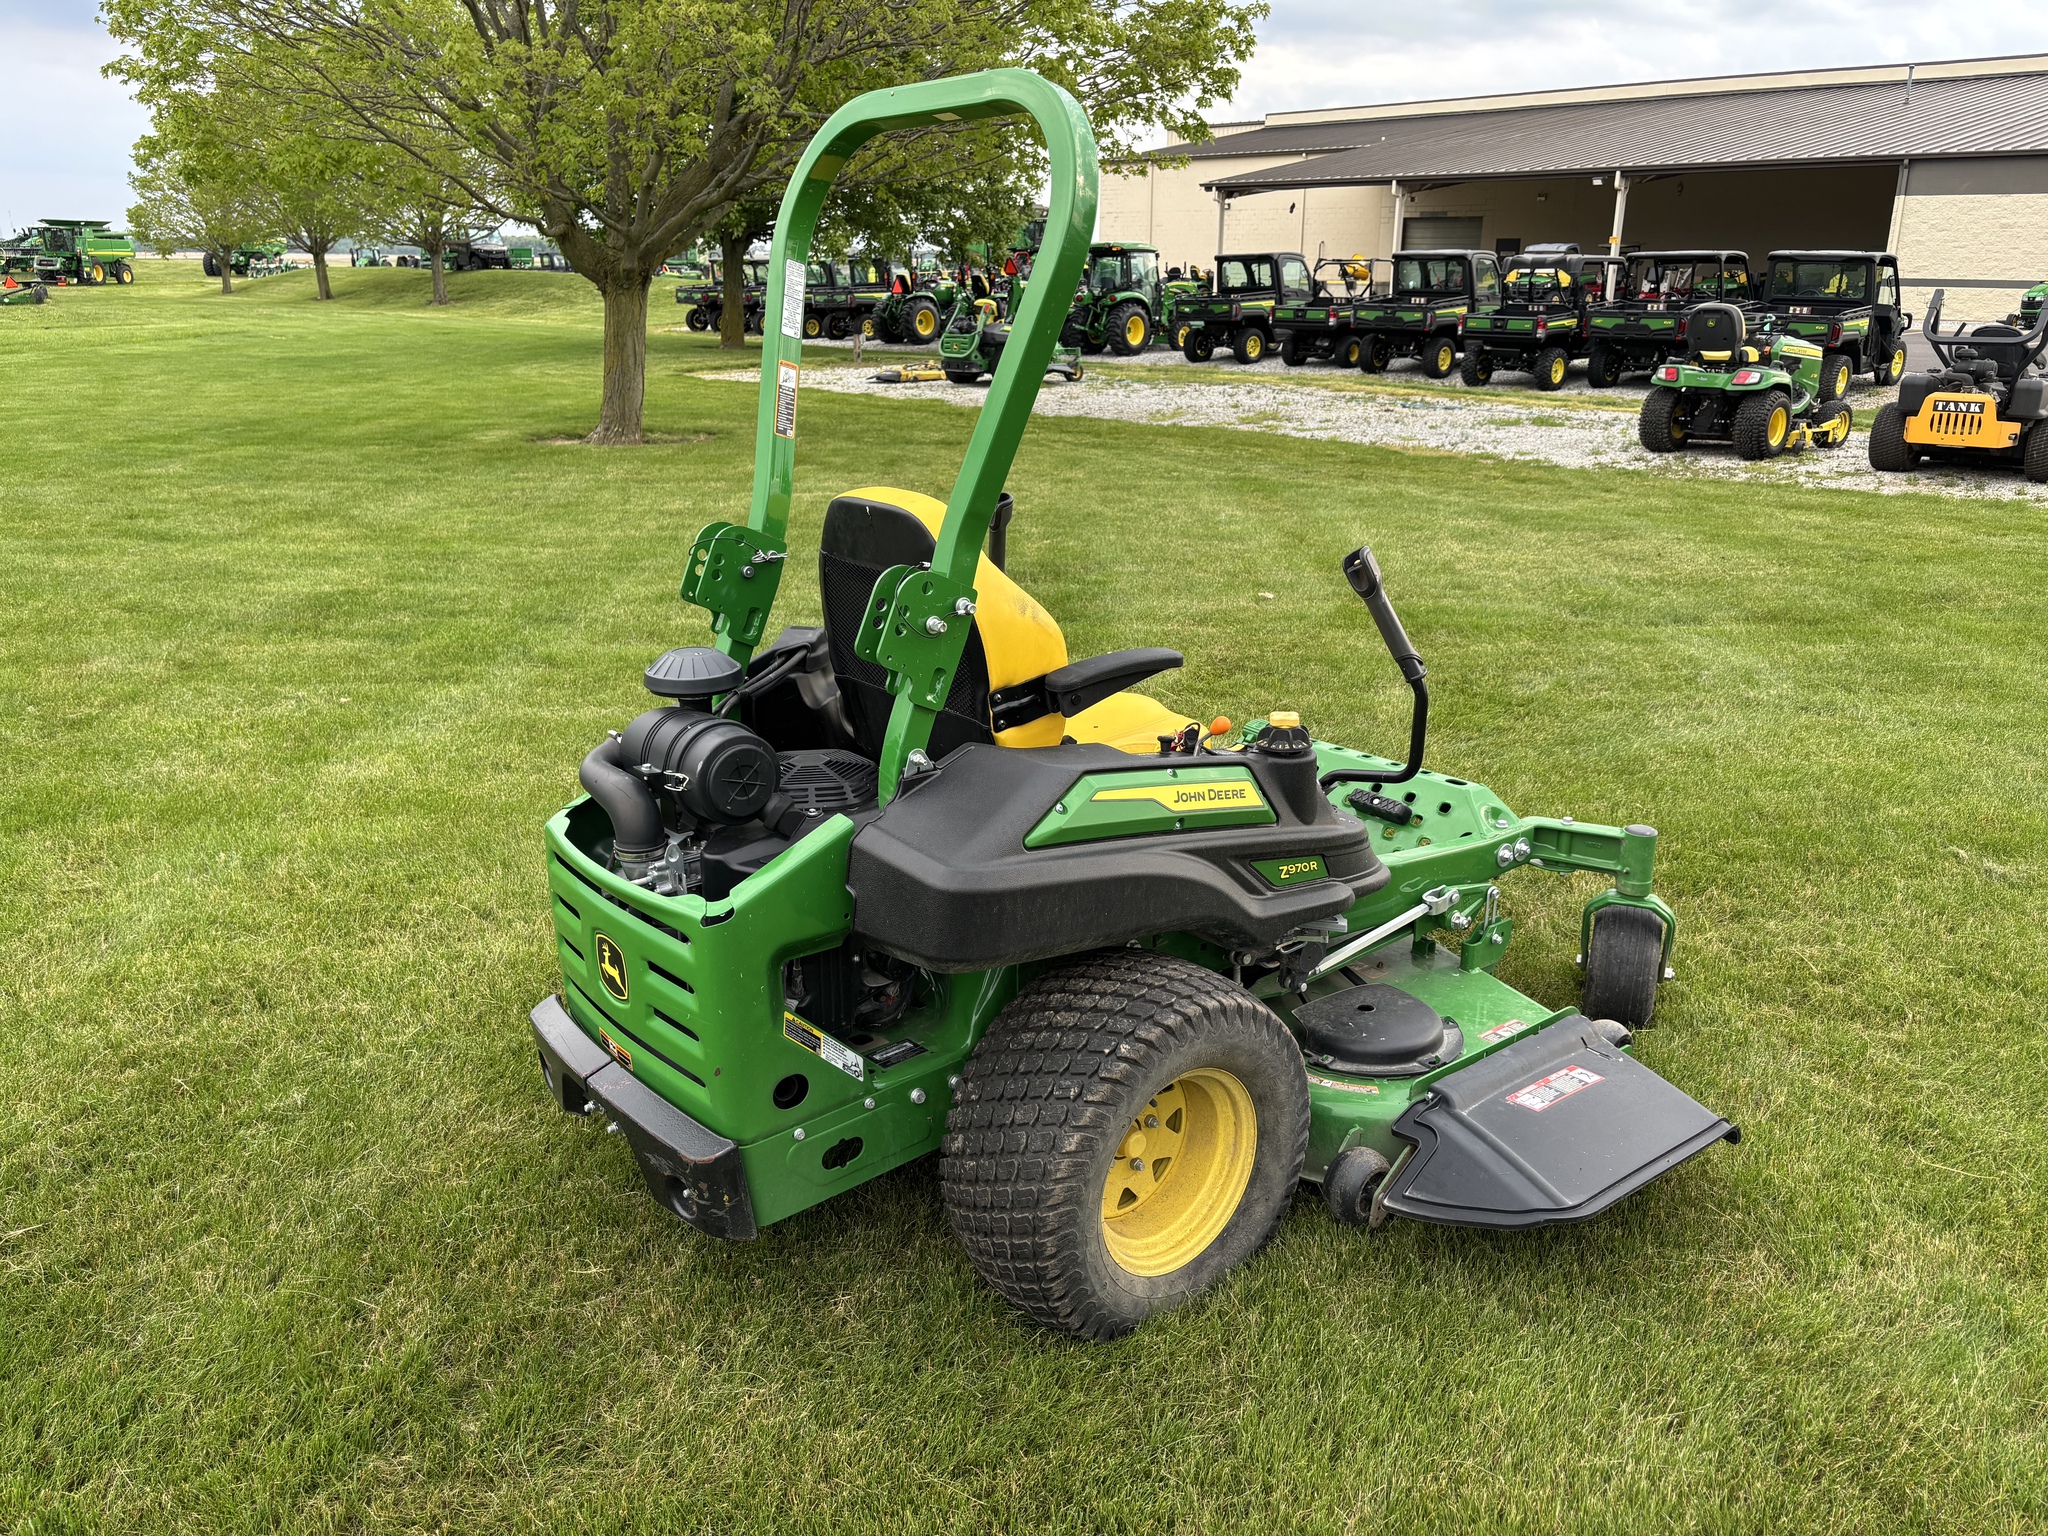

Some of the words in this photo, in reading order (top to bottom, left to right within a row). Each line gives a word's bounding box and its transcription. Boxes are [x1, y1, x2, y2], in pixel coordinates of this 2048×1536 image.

[1935, 401, 1983, 413] TANK
[1173, 790, 1206, 804] JOHN
[1207, 788, 1247, 801] DEERE
[1278, 860, 1318, 879] Z970R
[795, 1019, 814, 1033] CAUTION
